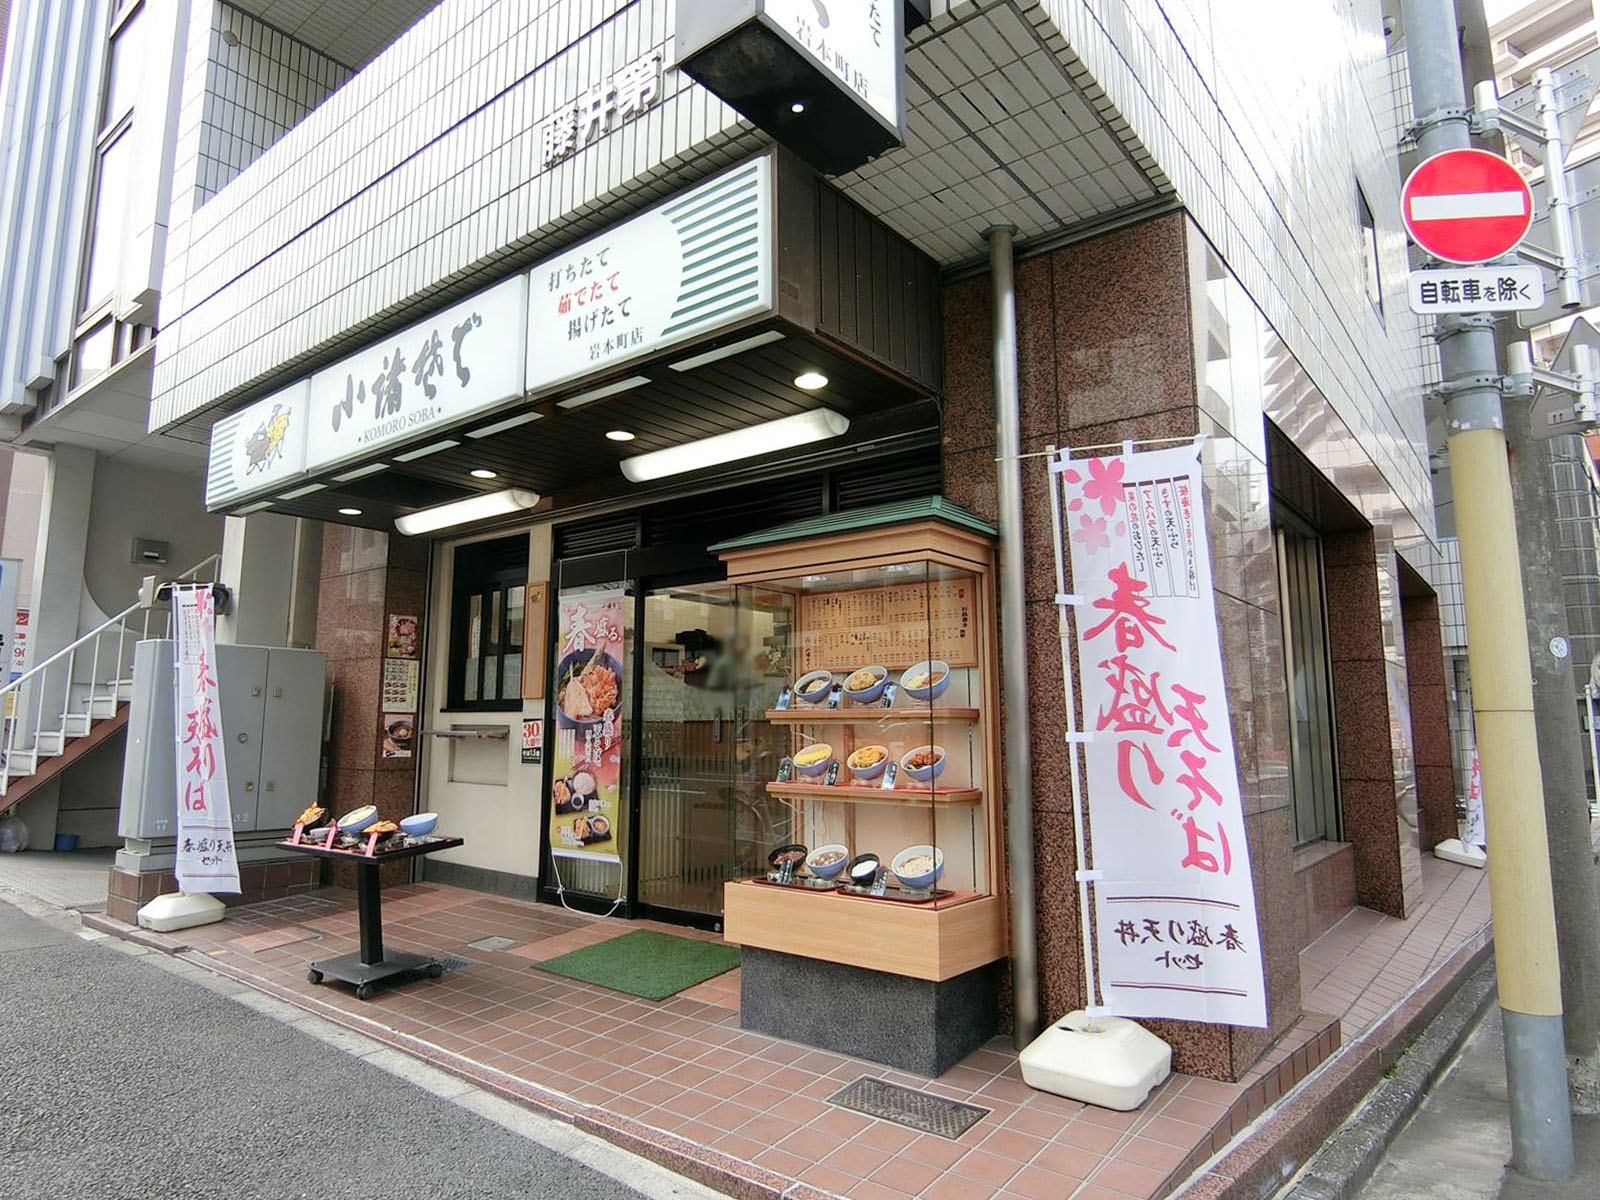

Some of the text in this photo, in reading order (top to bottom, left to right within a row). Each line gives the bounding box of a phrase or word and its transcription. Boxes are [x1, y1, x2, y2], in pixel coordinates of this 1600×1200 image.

[869, 0, 882, 48] たて
[796, 15, 868, 98] 岩本町店
[548, 246, 610, 292] 打ちたて
[1420, 276, 1531, 304] 自転車を除く
[558, 270, 621, 316] 茹でたて
[568, 296, 632, 341] 揚げたて
[590, 326, 643, 360] 岩本町店
[363, 405, 436, 444] KOMORO SOBA
[523, 722, 540, 738] 30
[183, 710, 208, 812] 天そば
[201, 855, 223, 867] セット
